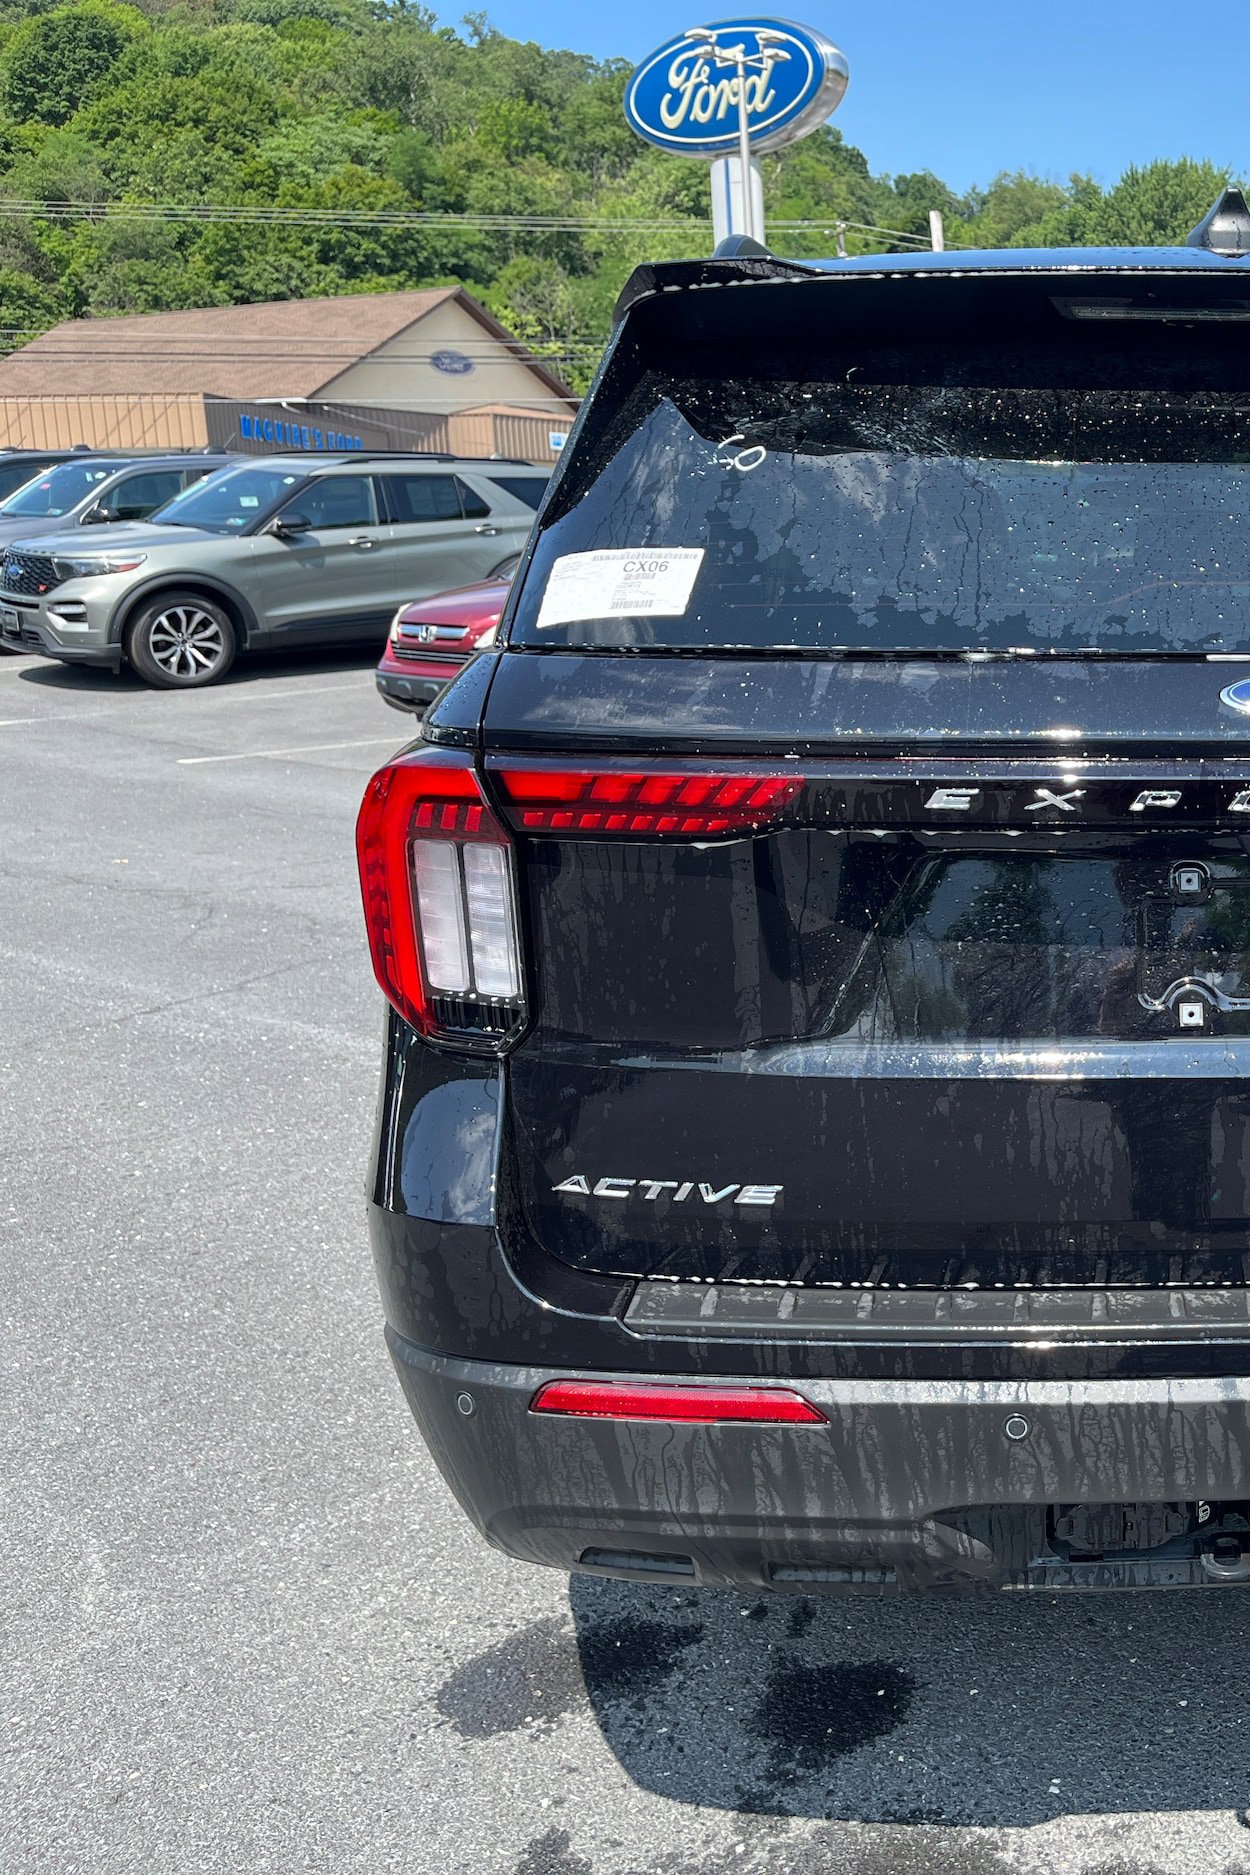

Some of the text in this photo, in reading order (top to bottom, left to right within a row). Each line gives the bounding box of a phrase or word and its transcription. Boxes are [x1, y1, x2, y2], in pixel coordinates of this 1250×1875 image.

[659, 43, 777, 129] Ford
[240, 414, 323, 450] MAGUIRE'S
[623, 560, 669, 573] CX06
[551, 1174, 785, 1205] ACTIVE
